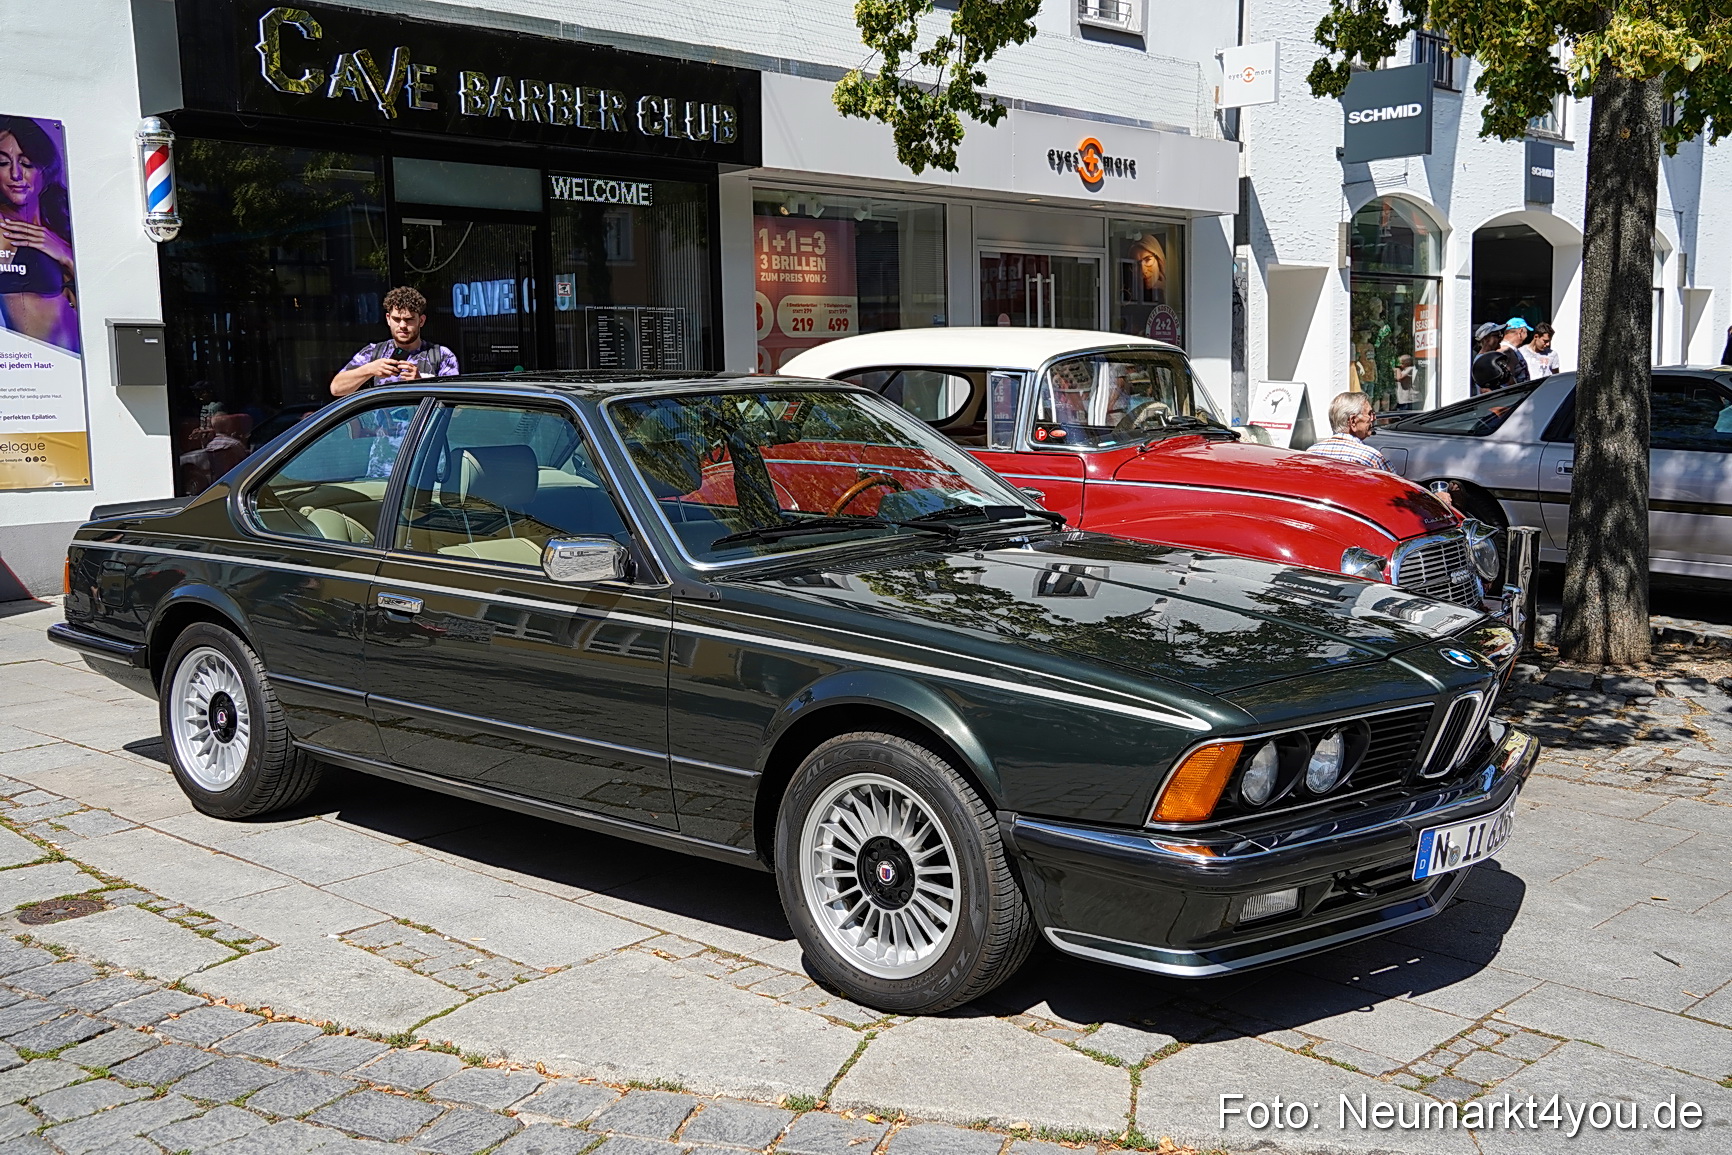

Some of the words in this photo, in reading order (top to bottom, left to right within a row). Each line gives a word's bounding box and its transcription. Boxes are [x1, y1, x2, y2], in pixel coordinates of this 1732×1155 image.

[255, 7, 437, 119] CAVE
[459, 71, 627, 133] BARBER
[637, 95, 738, 145] CLUB
[1228, 71, 1244, 80] eyes
[1254, 68, 1272, 76] more
[1348, 103, 1423, 125] SCHMID
[1047, 148, 1080, 165] eyes
[1102, 154, 1136, 172] more
[1531, 166, 1554, 178] SCHMID
[551, 176, 651, 205] WELCOME
[760, 254, 768, 270] 3
[772, 255, 826, 271] BRILLEN
[761, 272, 778, 281] ZUM
[780, 273, 803, 282] PREIS
[804, 273, 821, 283] VON
[822, 275, 827, 283] 2
[453, 279, 517, 318] CAVE
[792, 317, 814, 331] 219
[828, 317, 849, 331] 499
[1155, 318, 1172, 331] 2+2
[1415, 333, 1434, 348] SALE
[9, 362, 33, 370] jedem
[1038, 430, 1046, 439] P
[1432, 831, 1450, 870] N
[1419, 858, 1427, 870] D
